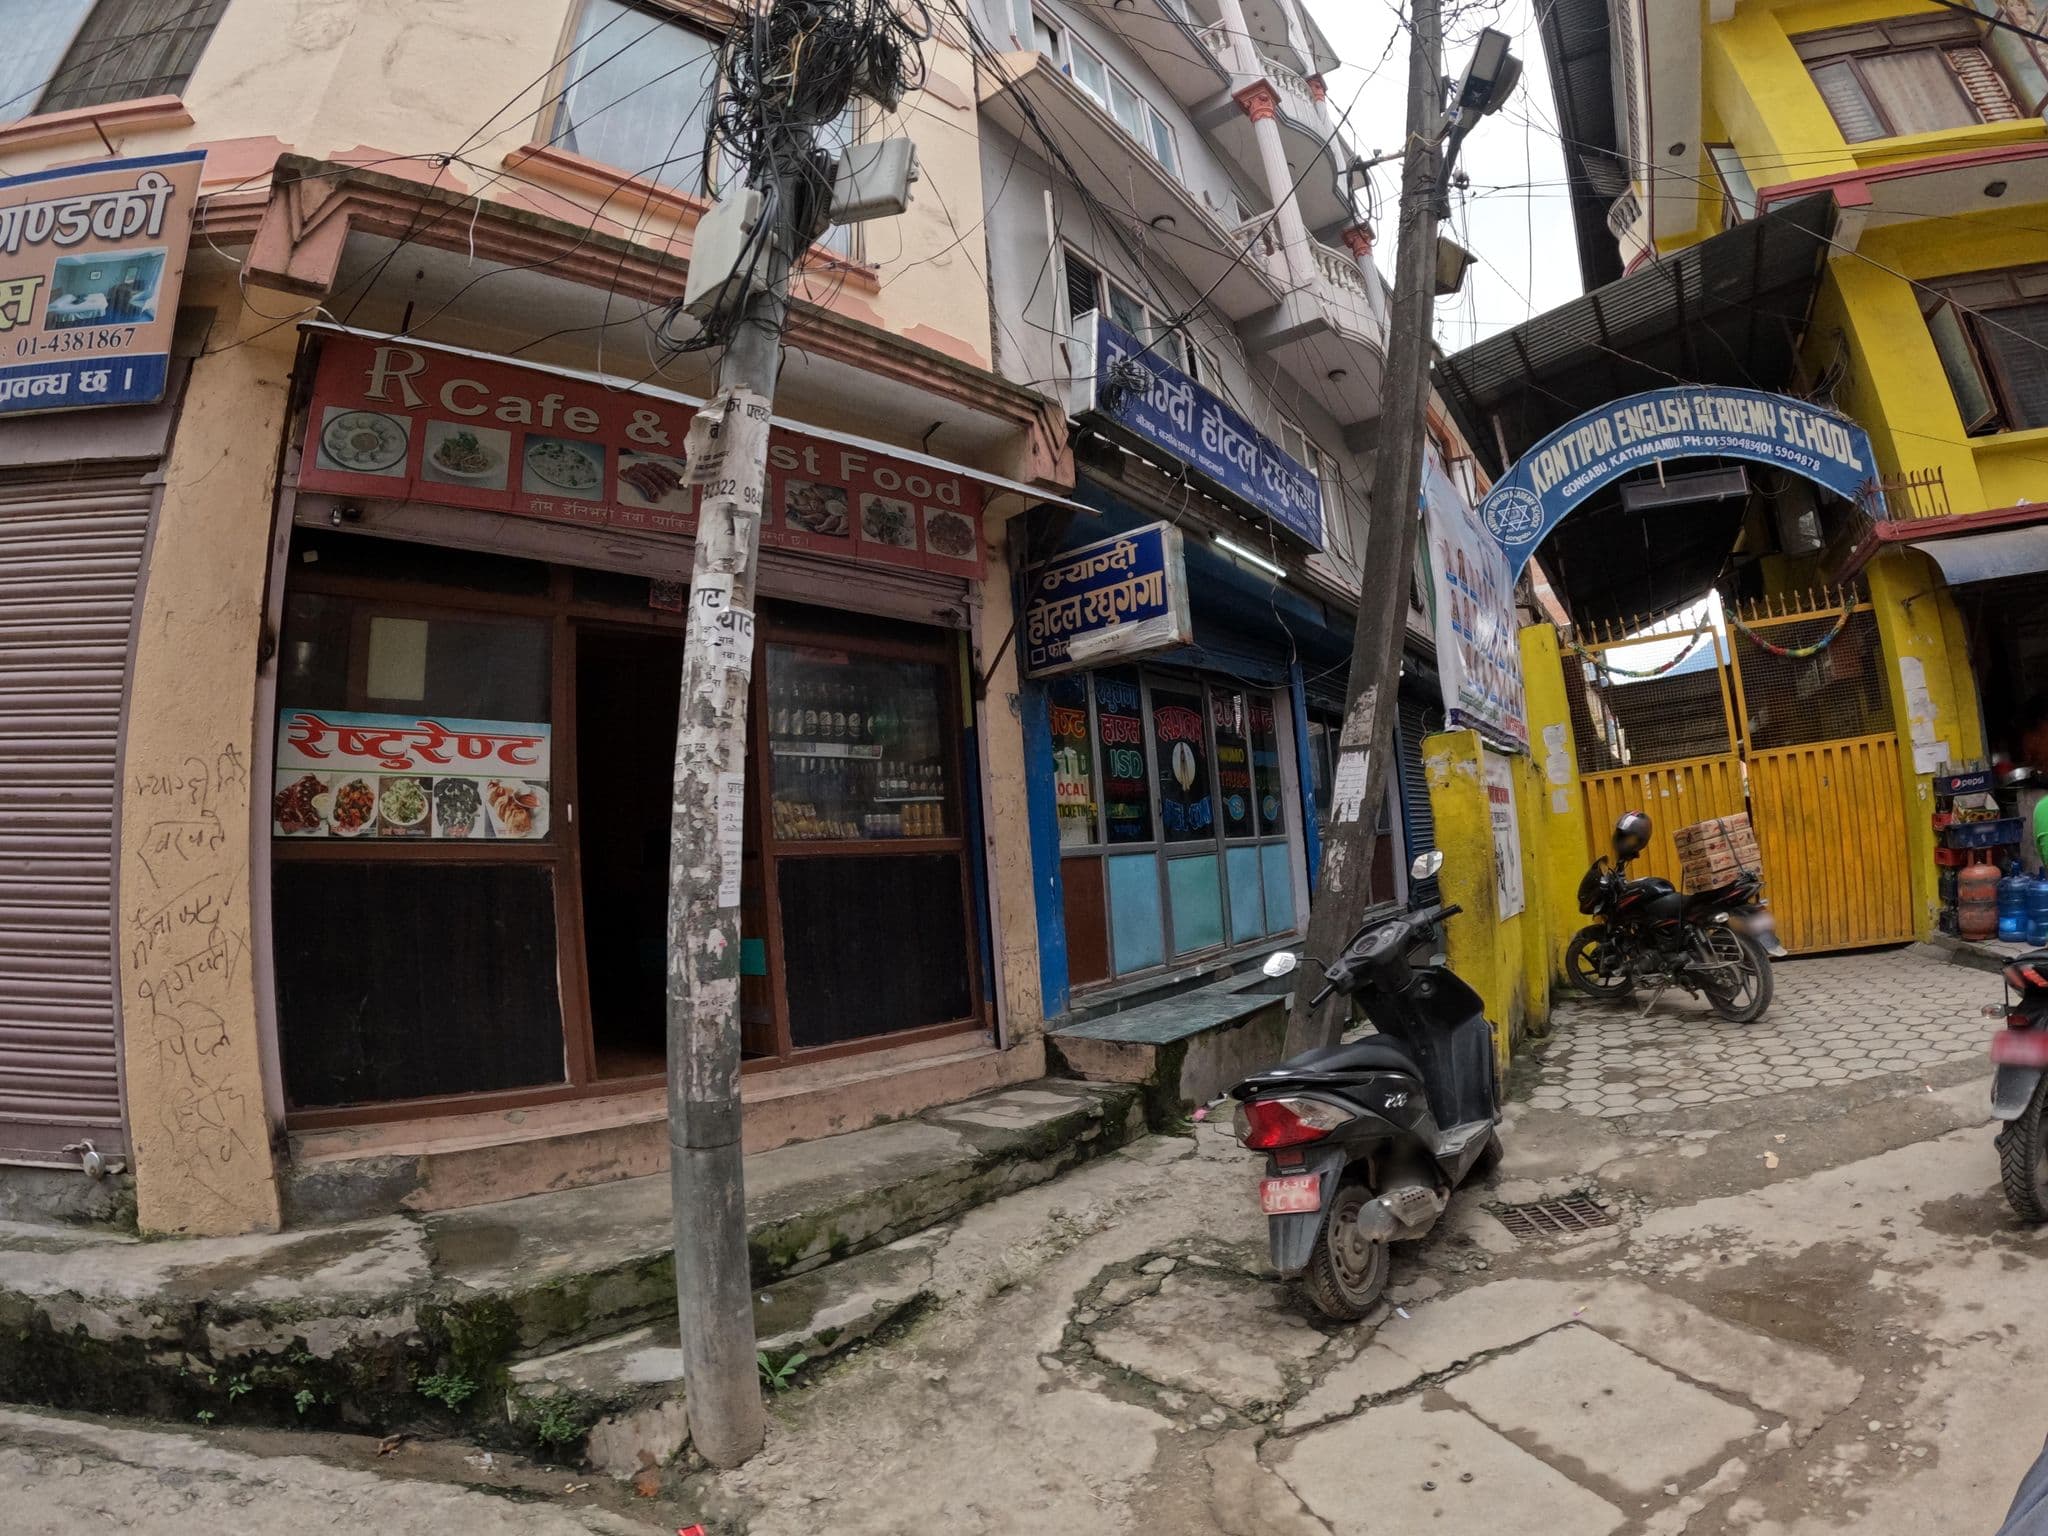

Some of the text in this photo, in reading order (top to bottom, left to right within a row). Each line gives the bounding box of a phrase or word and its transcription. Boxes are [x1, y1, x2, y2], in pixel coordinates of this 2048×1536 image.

[16, 327, 135, 357] 01-4381867
[362, 345, 432, 412] R
[439, 378, 600, 434] Cafe
[624, 409, 673, 447] &
[839, 451, 961, 506] Food
[1201, 404, 1259, 478] होटल
[1529, 396, 1863, 499] KANTIPUR ENGLISH ACADEMY SCHOOL
[1026, 593, 1082, 646] होटल
[1109, 749, 1144, 779] ISD
[1961, 775, 1985, 788] pepsi
